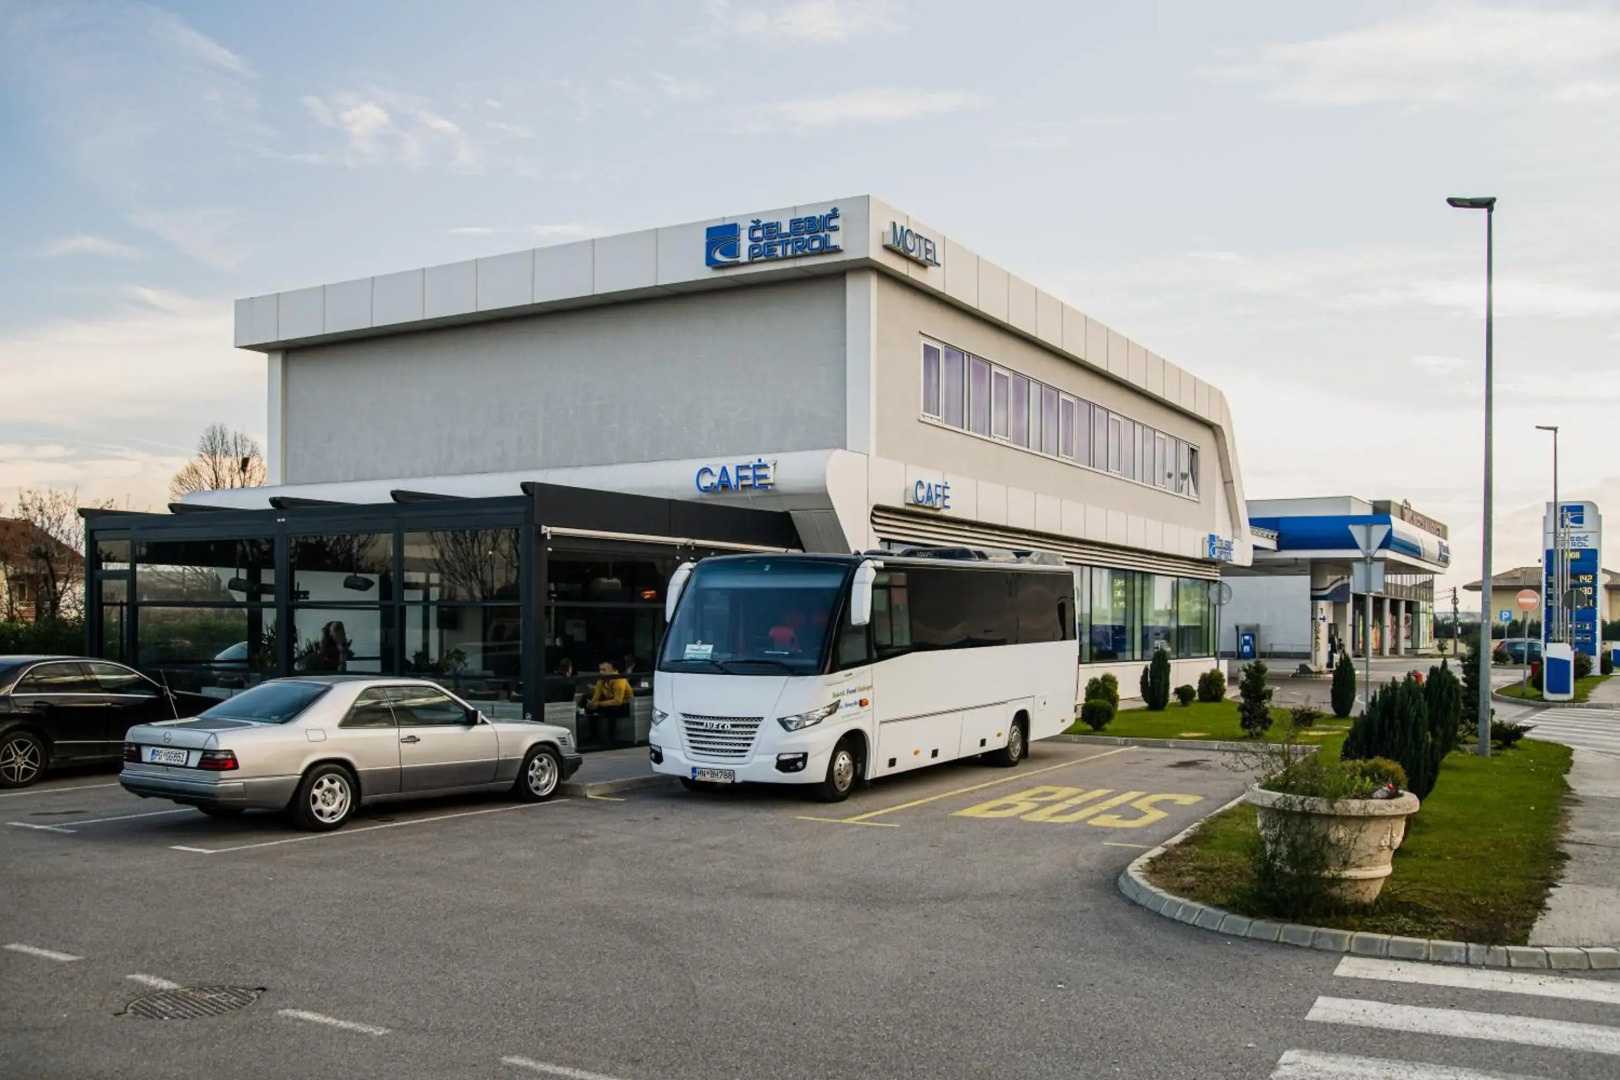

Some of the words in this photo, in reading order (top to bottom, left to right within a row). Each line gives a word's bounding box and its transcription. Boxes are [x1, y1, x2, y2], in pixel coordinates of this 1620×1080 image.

[748, 207, 840, 243] ČELEBIĆ
[748, 232, 838, 262] PETROL
[891, 221, 941, 267] MOTEL
[1502, 611, 1510, 621] P
[704, 720, 731, 731] IVECO
[948, 785, 1204, 828] BUS
